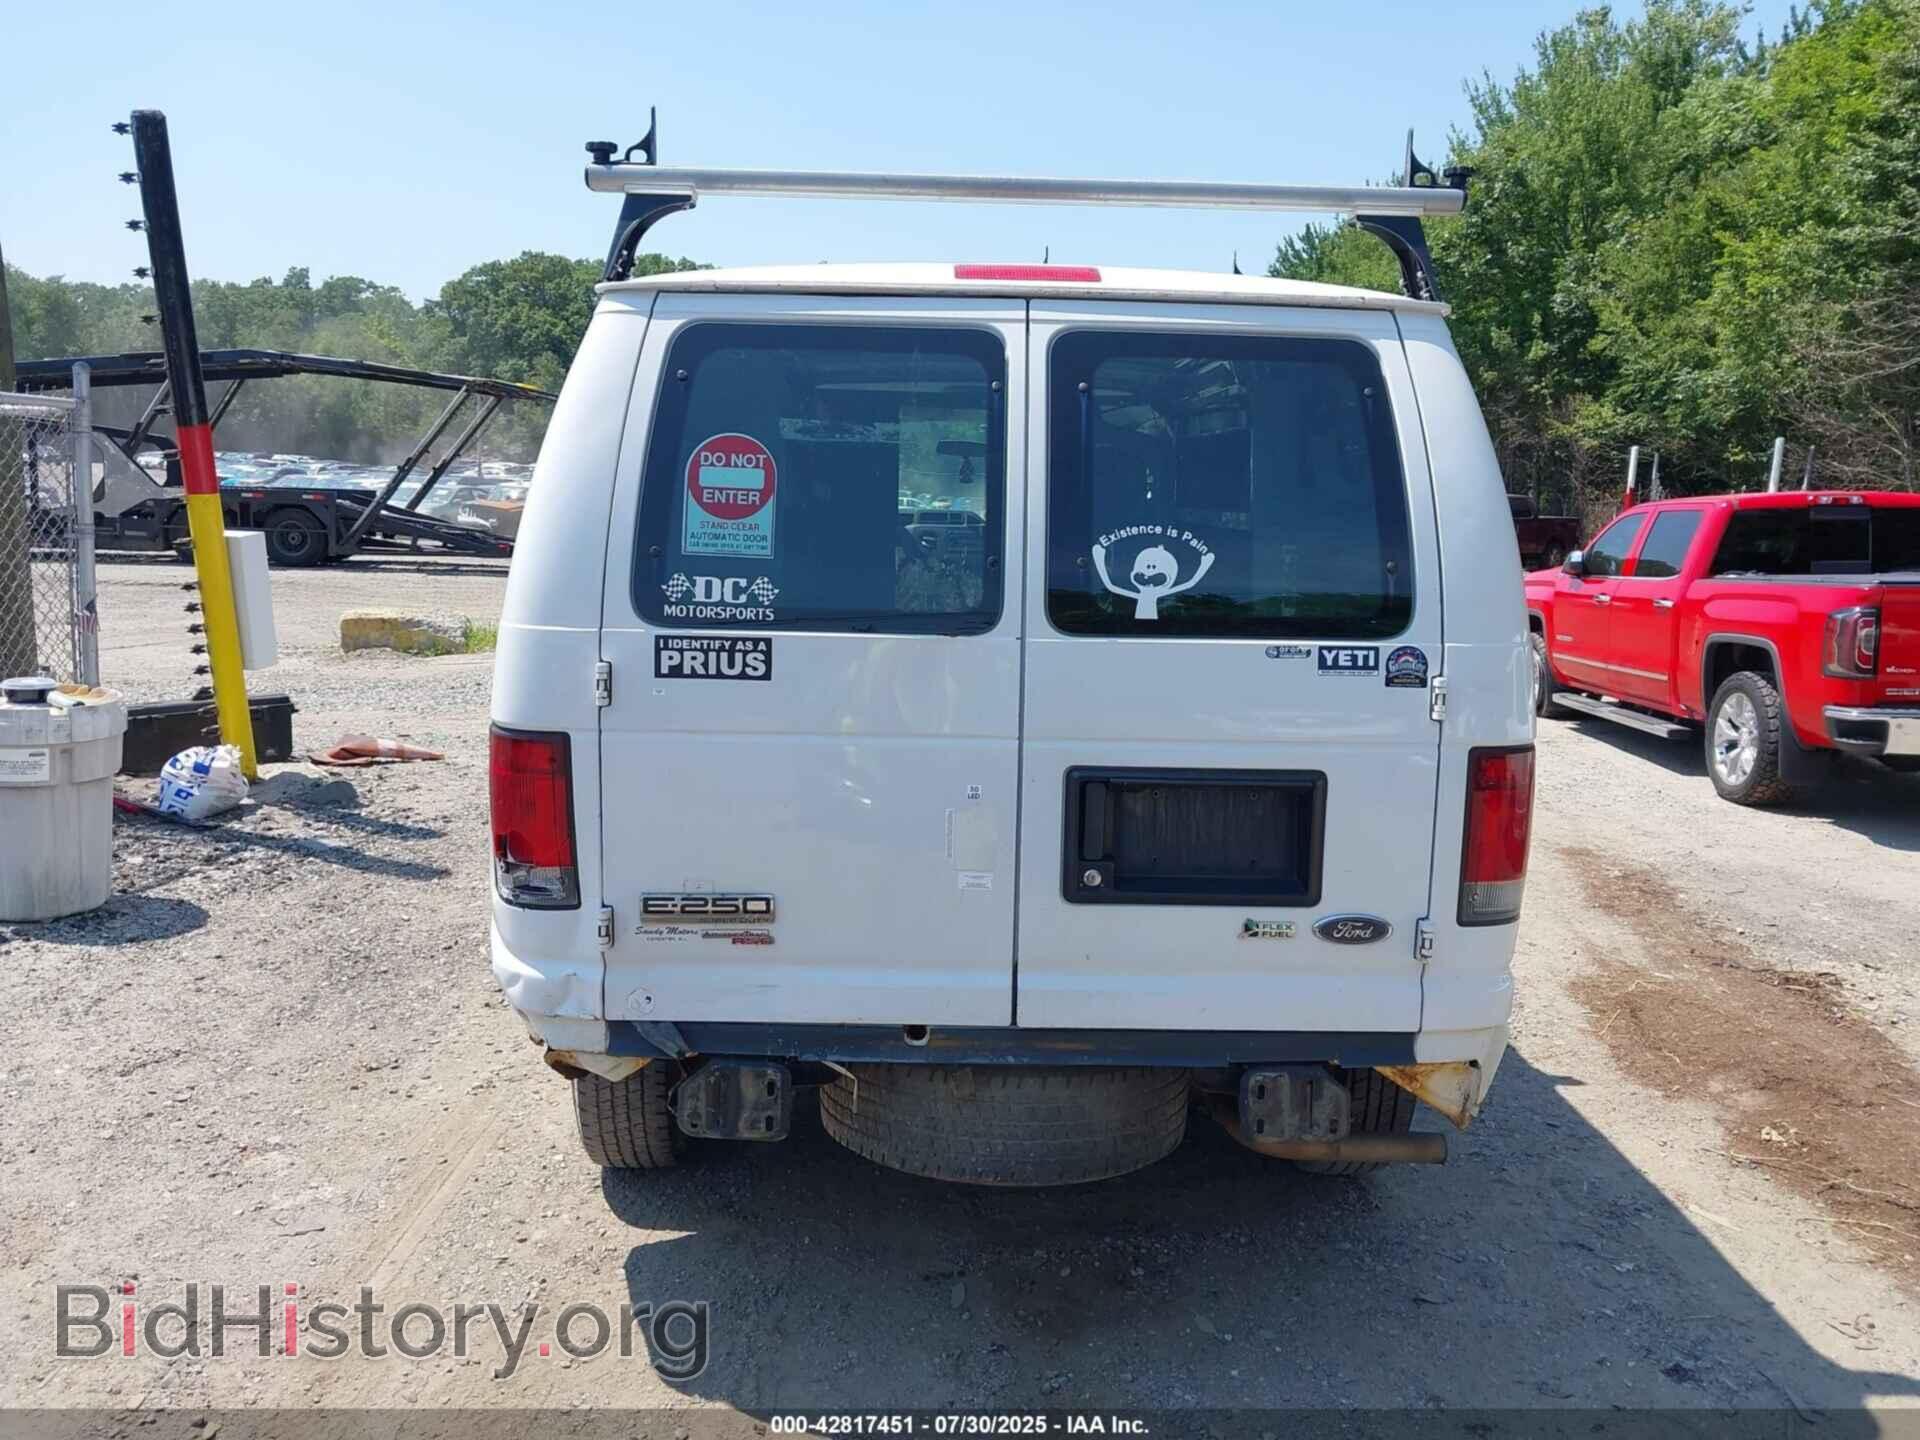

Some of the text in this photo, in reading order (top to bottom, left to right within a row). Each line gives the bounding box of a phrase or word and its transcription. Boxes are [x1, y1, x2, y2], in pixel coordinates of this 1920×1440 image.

[700, 452, 767, 468] DO NOT
[703, 489, 761, 505] ENTER
[699, 520, 760, 532] STAND CLEAR
[690, 531, 768, 544] AUTOMATIC DOOR
[1099, 525, 1208, 554] Existence is Pain
[692, 576, 748, 603] DC
[663, 604, 775, 621] MOTORSPORTS
[660, 639, 767, 651] I IDENTIFY AS A
[660, 650, 766, 677] PRIUS
[1321, 649, 1375, 667] YETI
[635, 926, 664, 936] Sandy
[665, 926, 699, 935] Motors
[1262, 923, 1293, 931] FLEX
[1333, 921, 1375, 938] Ford
